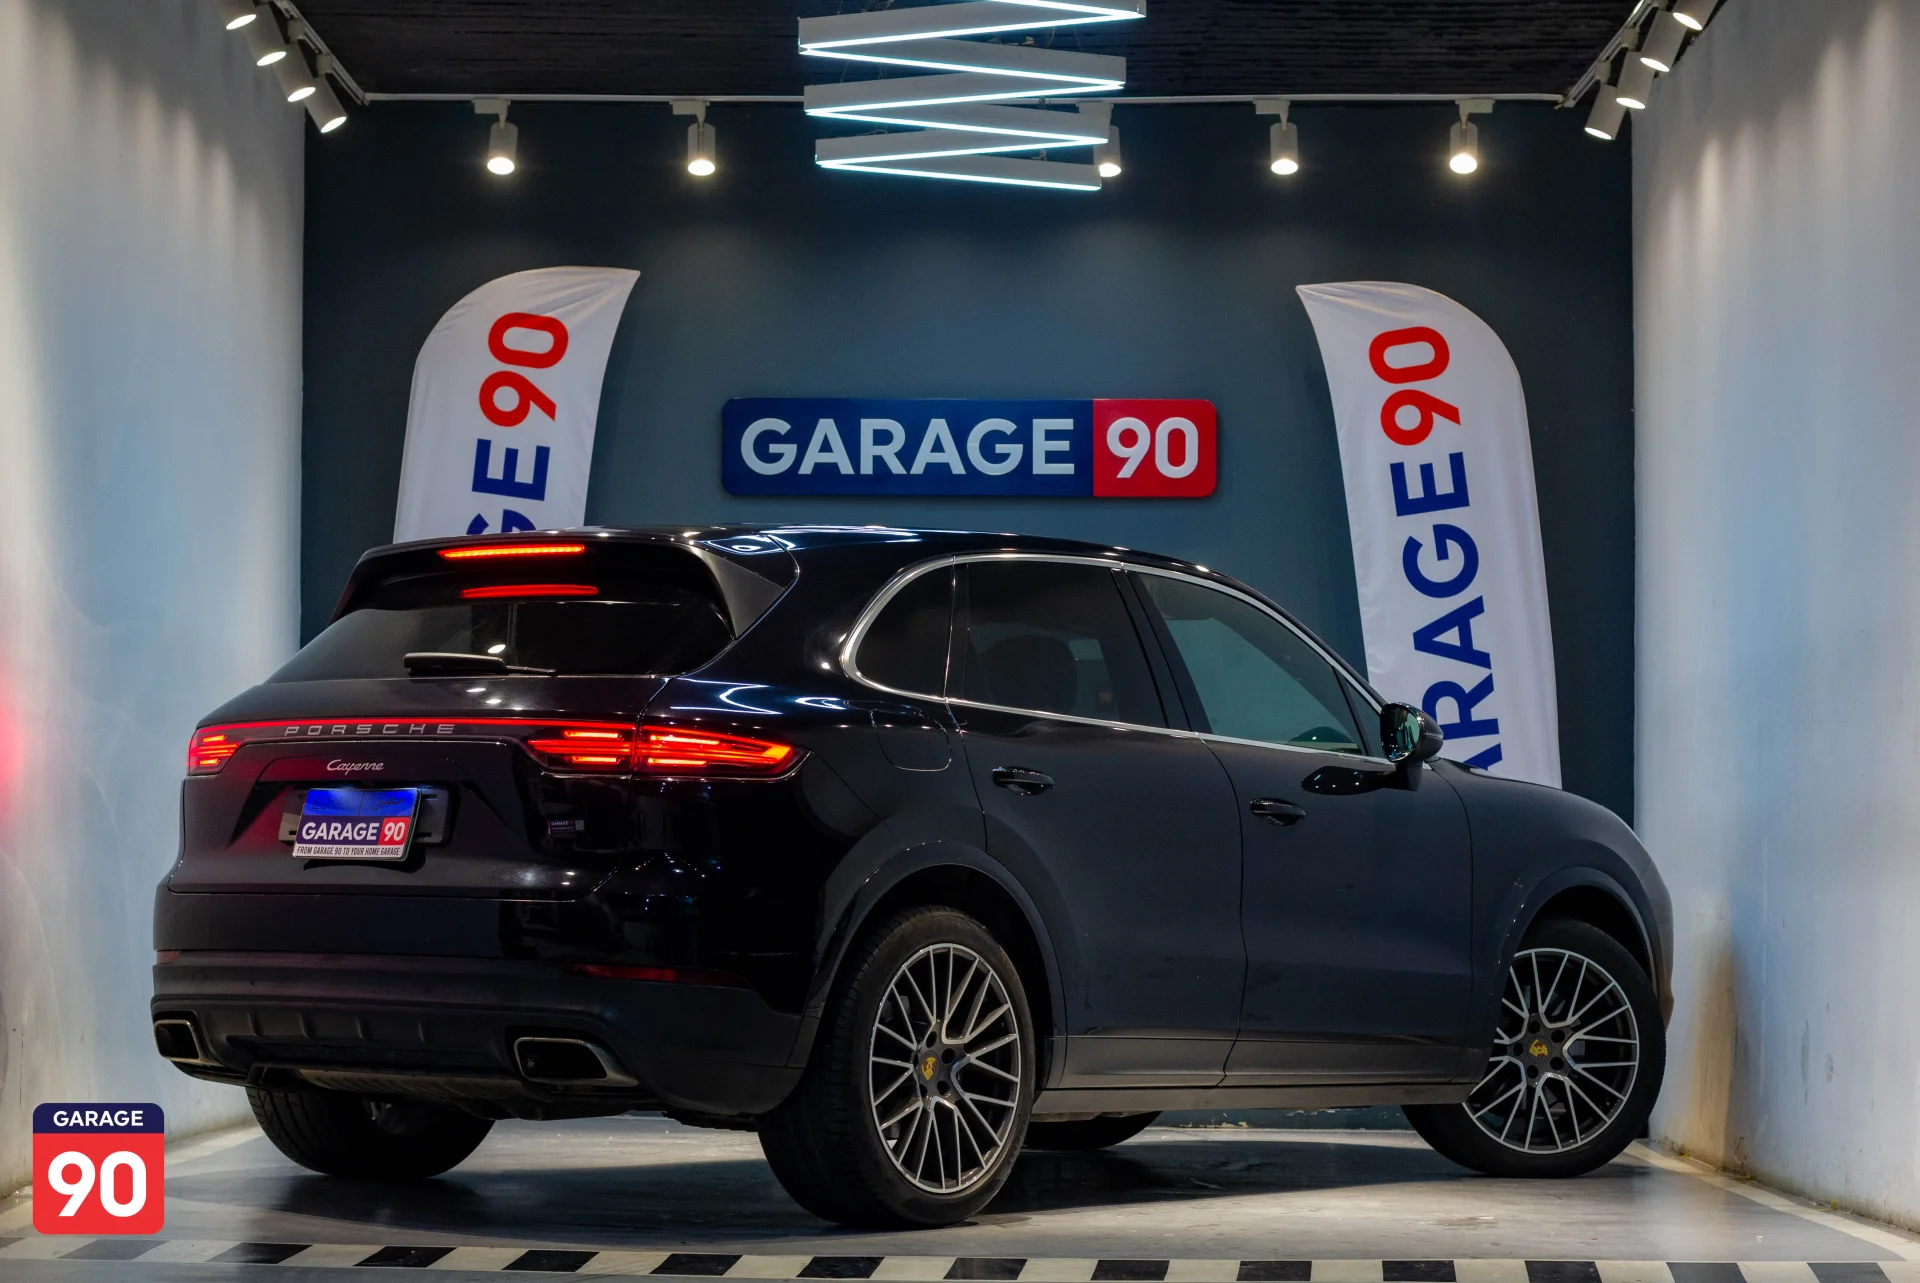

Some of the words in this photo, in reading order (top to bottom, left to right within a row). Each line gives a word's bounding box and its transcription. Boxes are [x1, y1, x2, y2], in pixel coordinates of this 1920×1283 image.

[478, 312, 568, 427] 90
[1369, 326, 1461, 446] 90
[740, 417, 1075, 475] GARAGE
[1106, 416, 1199, 479] 90
[284, 723, 456, 737] PORSCHE
[326, 759, 385, 775] Cayenne
[301, 822, 380, 841] GARAGE
[384, 821, 406, 842] 90
[297, 846, 313, 855] FROM
[313, 846, 334, 855] GARAGE
[334, 847, 342, 855] 90
[343, 847, 350, 856] TO
[351, 847, 364, 856] YOUR
[364, 847, 380, 856] HOME
[380, 847, 401, 856] GARAGE
